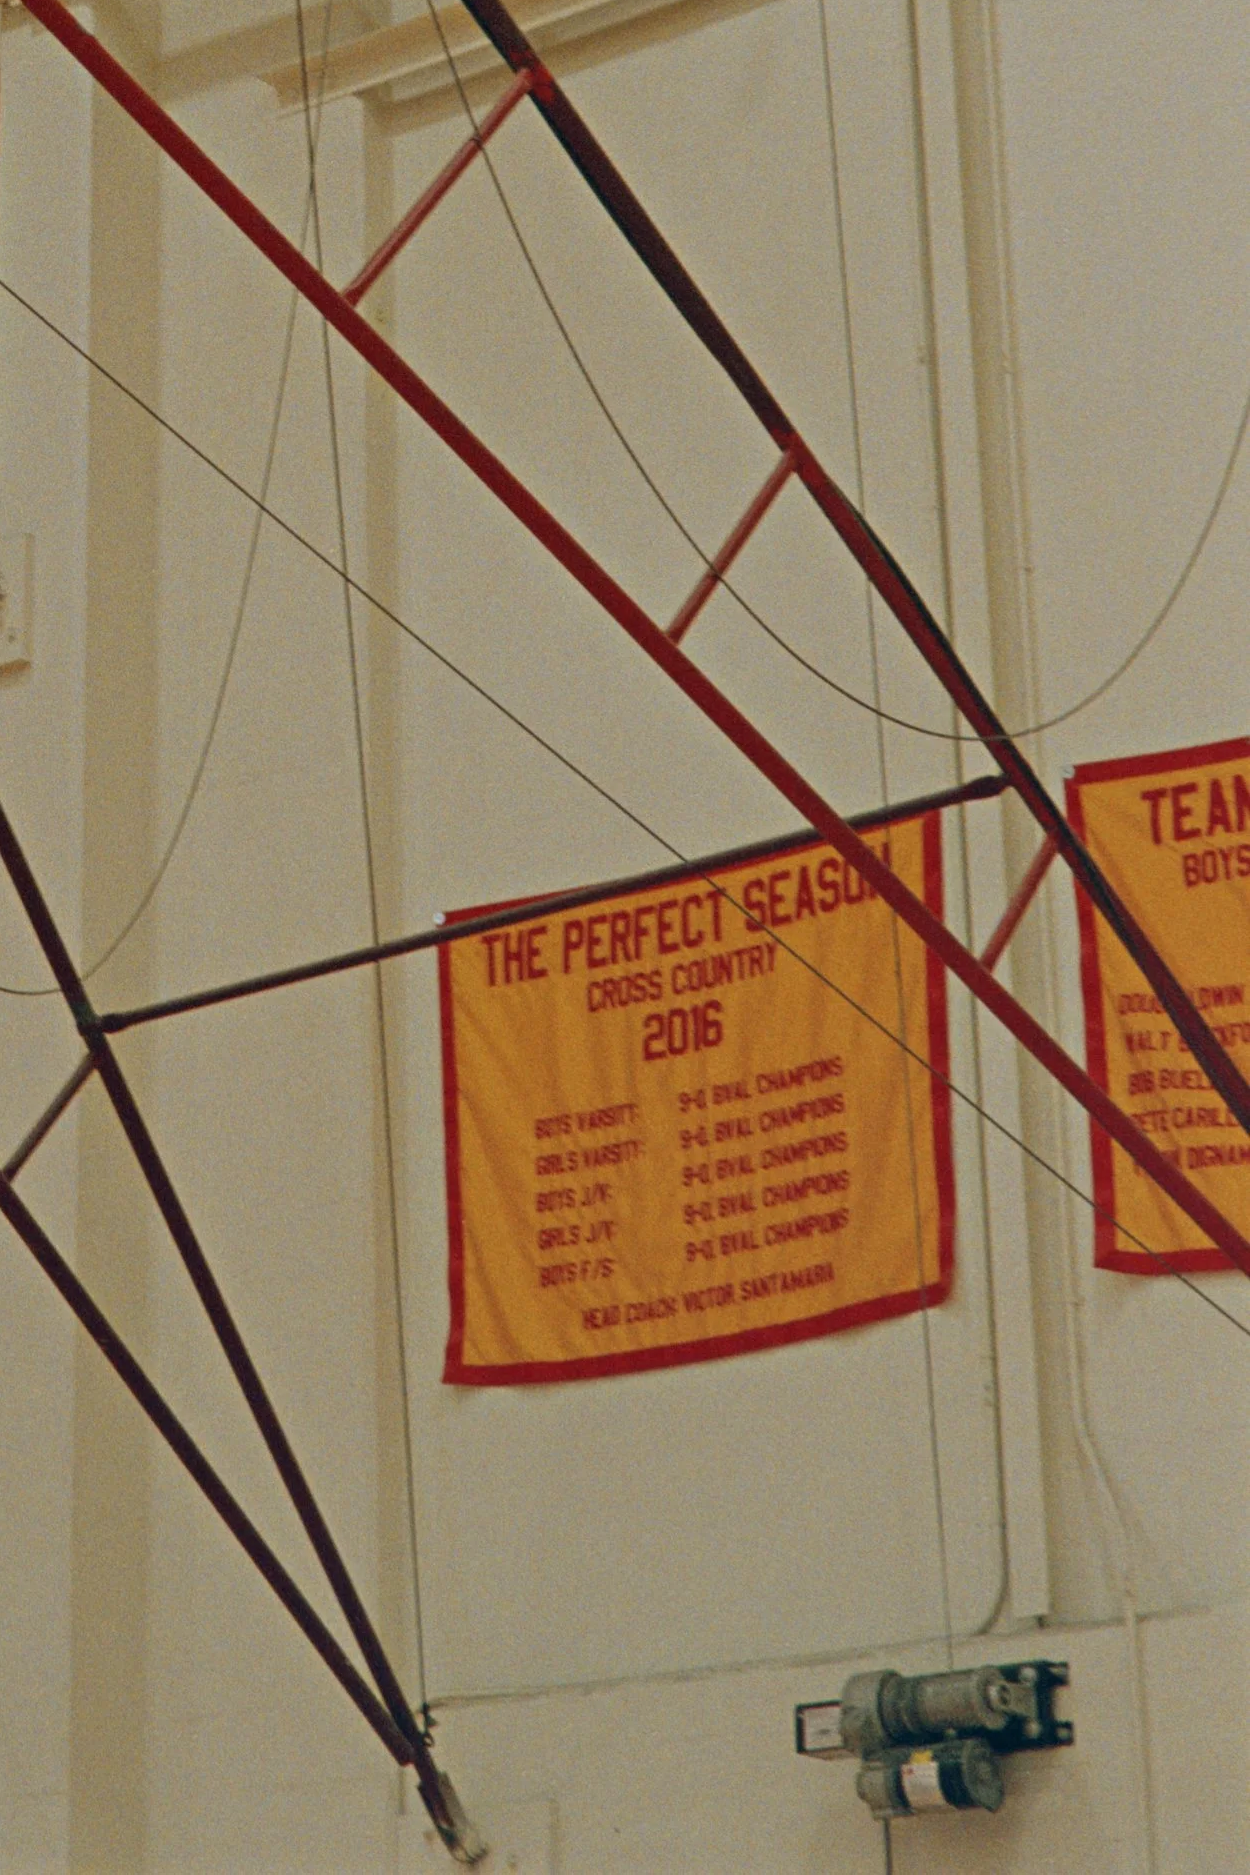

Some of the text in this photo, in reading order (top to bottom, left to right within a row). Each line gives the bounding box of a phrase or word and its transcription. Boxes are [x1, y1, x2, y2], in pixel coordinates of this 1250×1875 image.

[481, 925, 549, 988] THE
[563, 886, 729, 975] PERFECT
[586, 941, 780, 1014] CROSS COUNTRY
[642, 1000, 725, 1061] 2016
